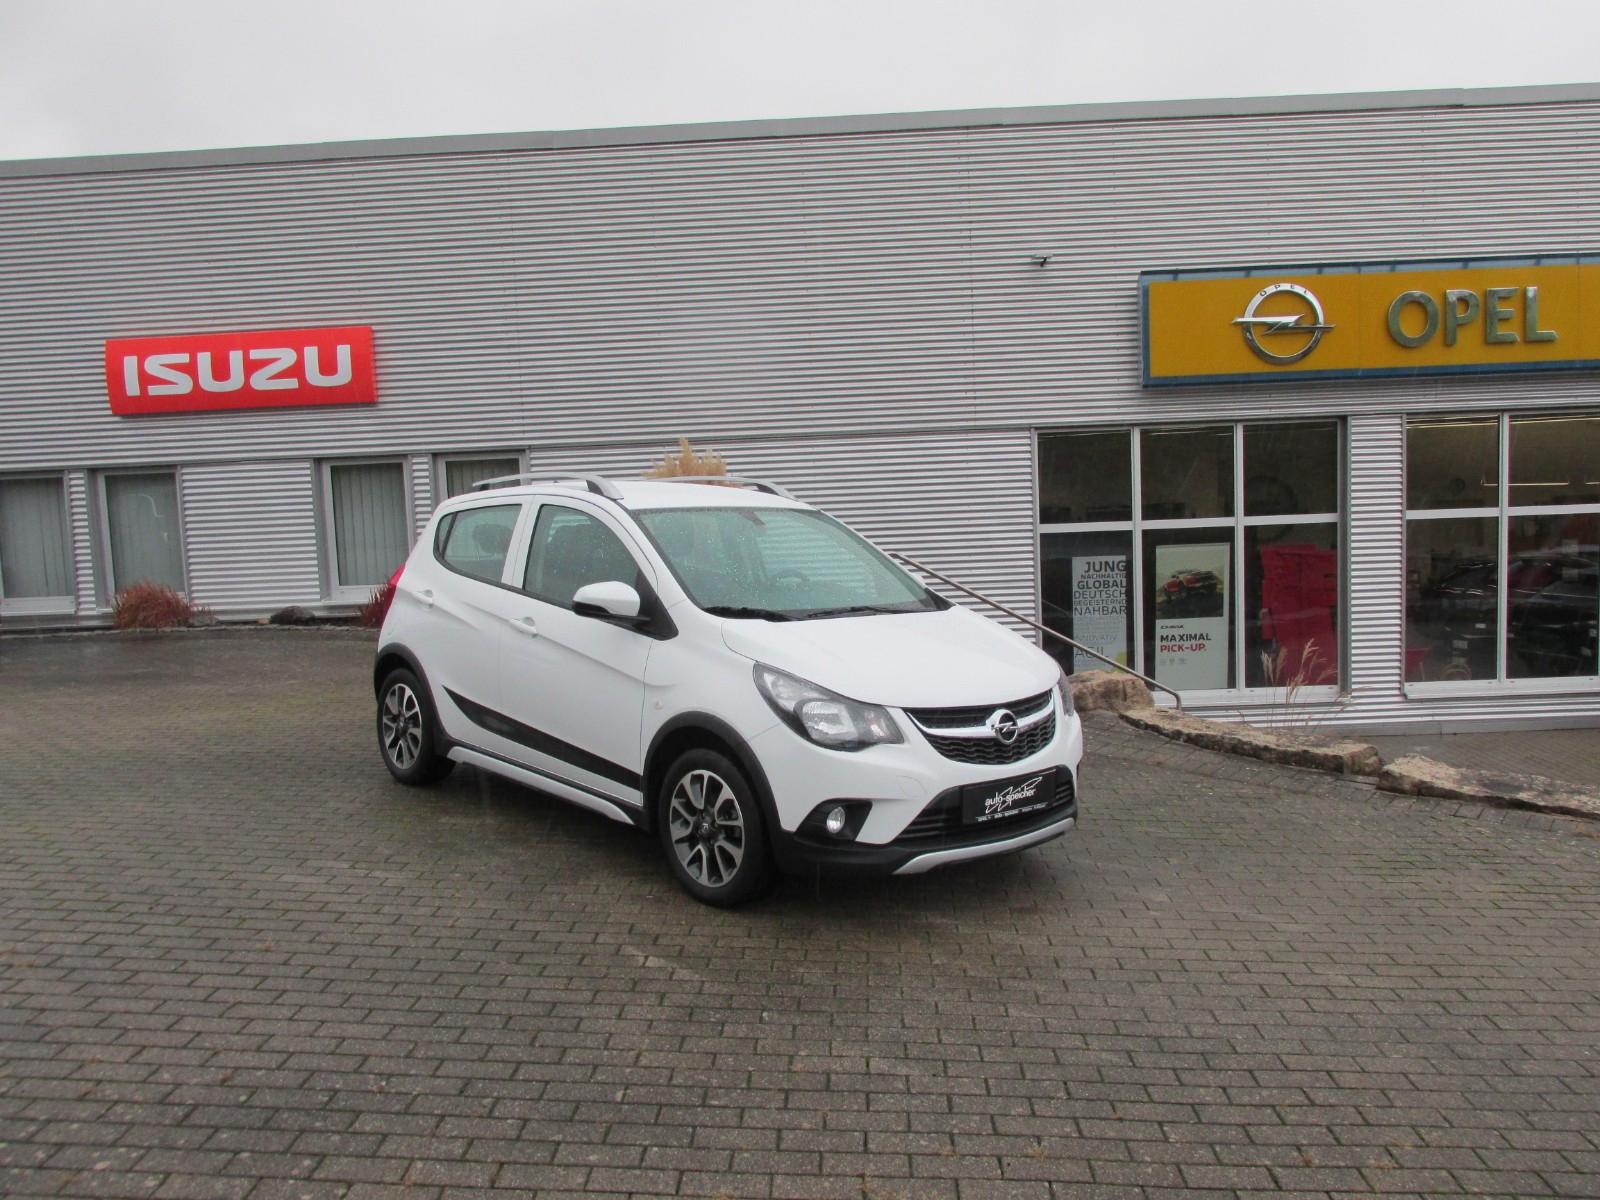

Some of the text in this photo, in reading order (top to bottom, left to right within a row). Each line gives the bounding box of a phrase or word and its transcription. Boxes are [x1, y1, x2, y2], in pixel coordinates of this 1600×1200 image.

[1258, 283, 1310, 298] OPEL
[1388, 286, 1558, 348] OPEL
[123, 344, 352, 397] ISUZU
[1084, 560, 1127, 573] JUNG
[1077, 579, 1127, 590] GLOBAL
[1074, 589, 1127, 599] DEUTSCH
[1074, 605, 1127, 617] NAHBAR
[1160, 632, 1212, 643] MAXIMAL
